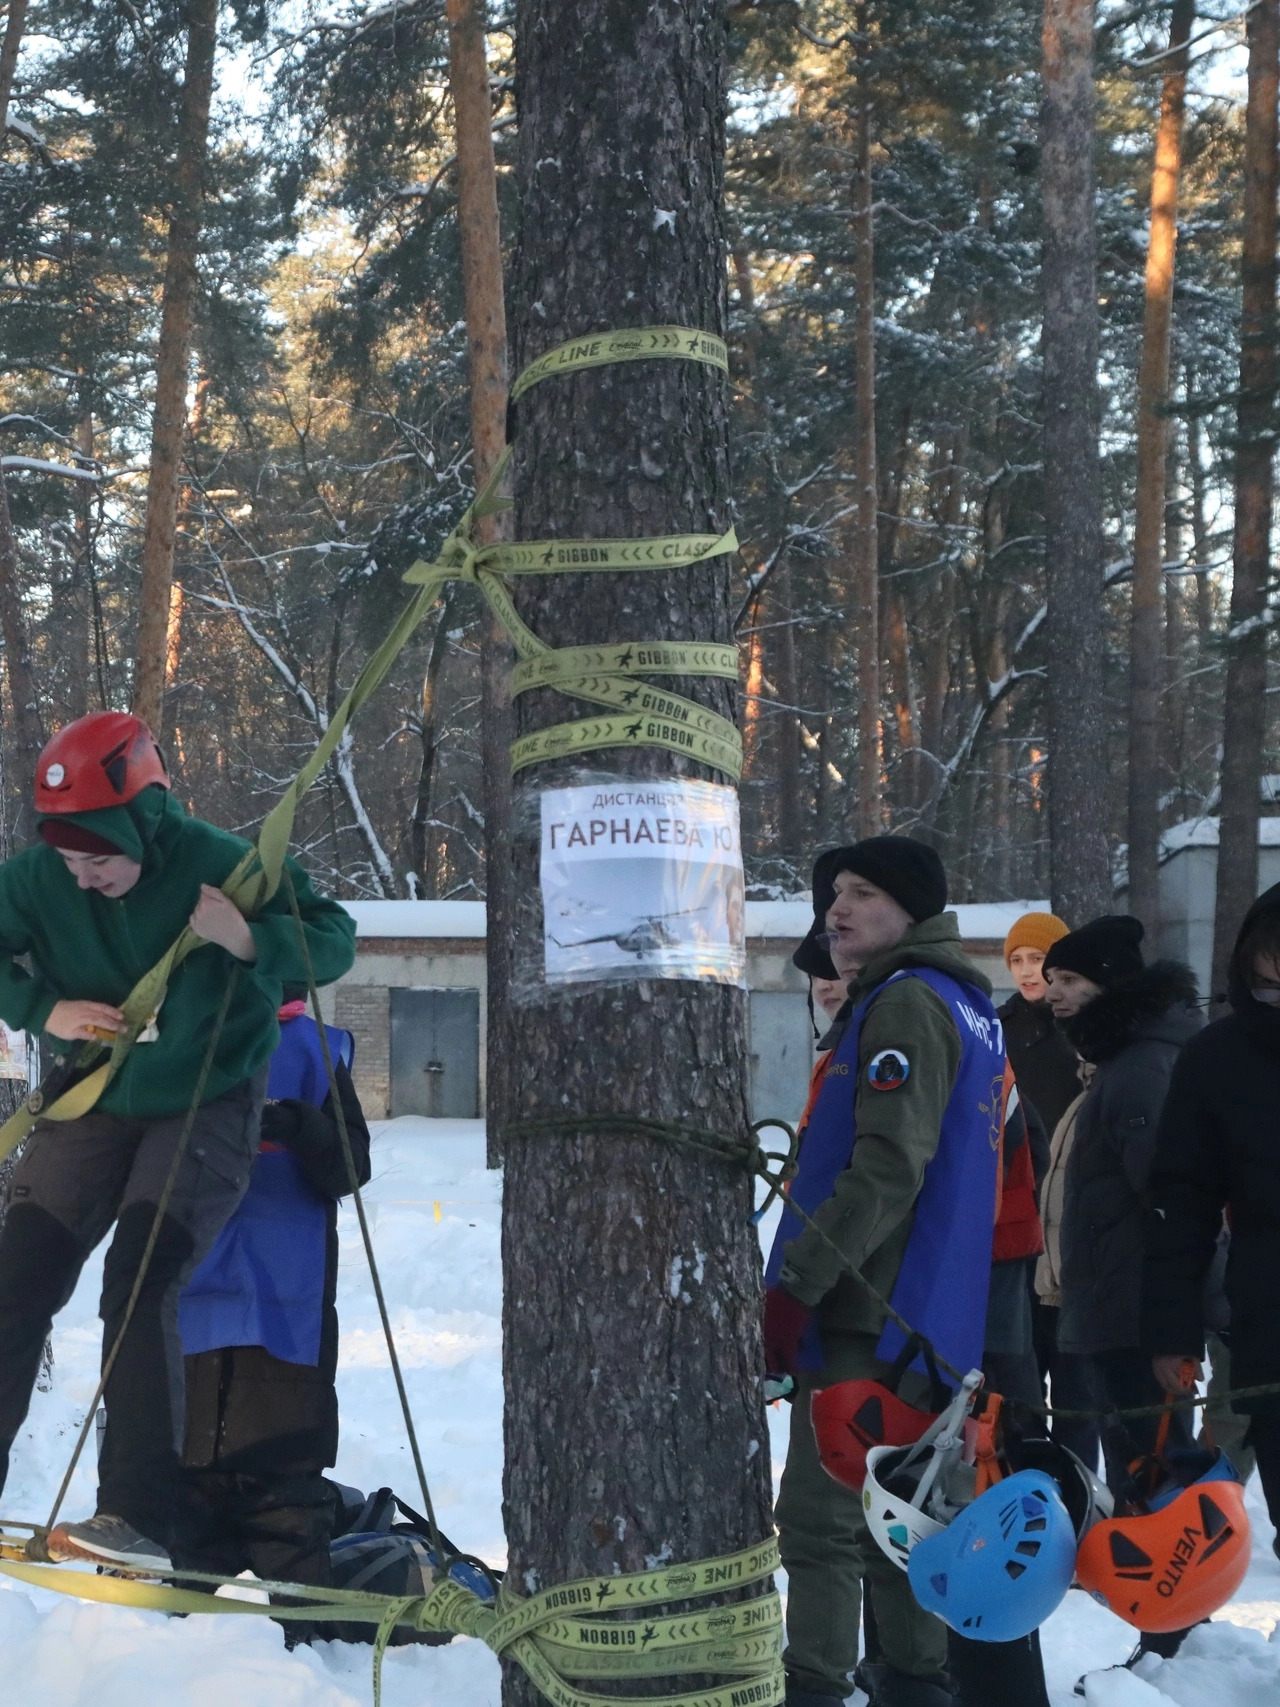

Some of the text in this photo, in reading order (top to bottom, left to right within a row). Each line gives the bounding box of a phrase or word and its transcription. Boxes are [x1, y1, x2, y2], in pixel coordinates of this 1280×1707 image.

[559, 341, 602, 364] LINE
[558, 548, 609, 564] GIBBON
[638, 650, 687, 665] GIBBON
[641, 692, 689, 722] GIBBON
[647, 722, 694, 748] GIBBON
[550, 818, 704, 850] ГАРНАЕВА
[704, 1560, 742, 1585] LINE
[1157, 1526, 1202, 1597] VENTO
[545, 1586, 592, 1610] GIBBON
[742, 1606, 771, 1627] LINE
[579, 1627, 636, 1646] GIBBON
[731, 1685, 771, 1707] GIBBON
